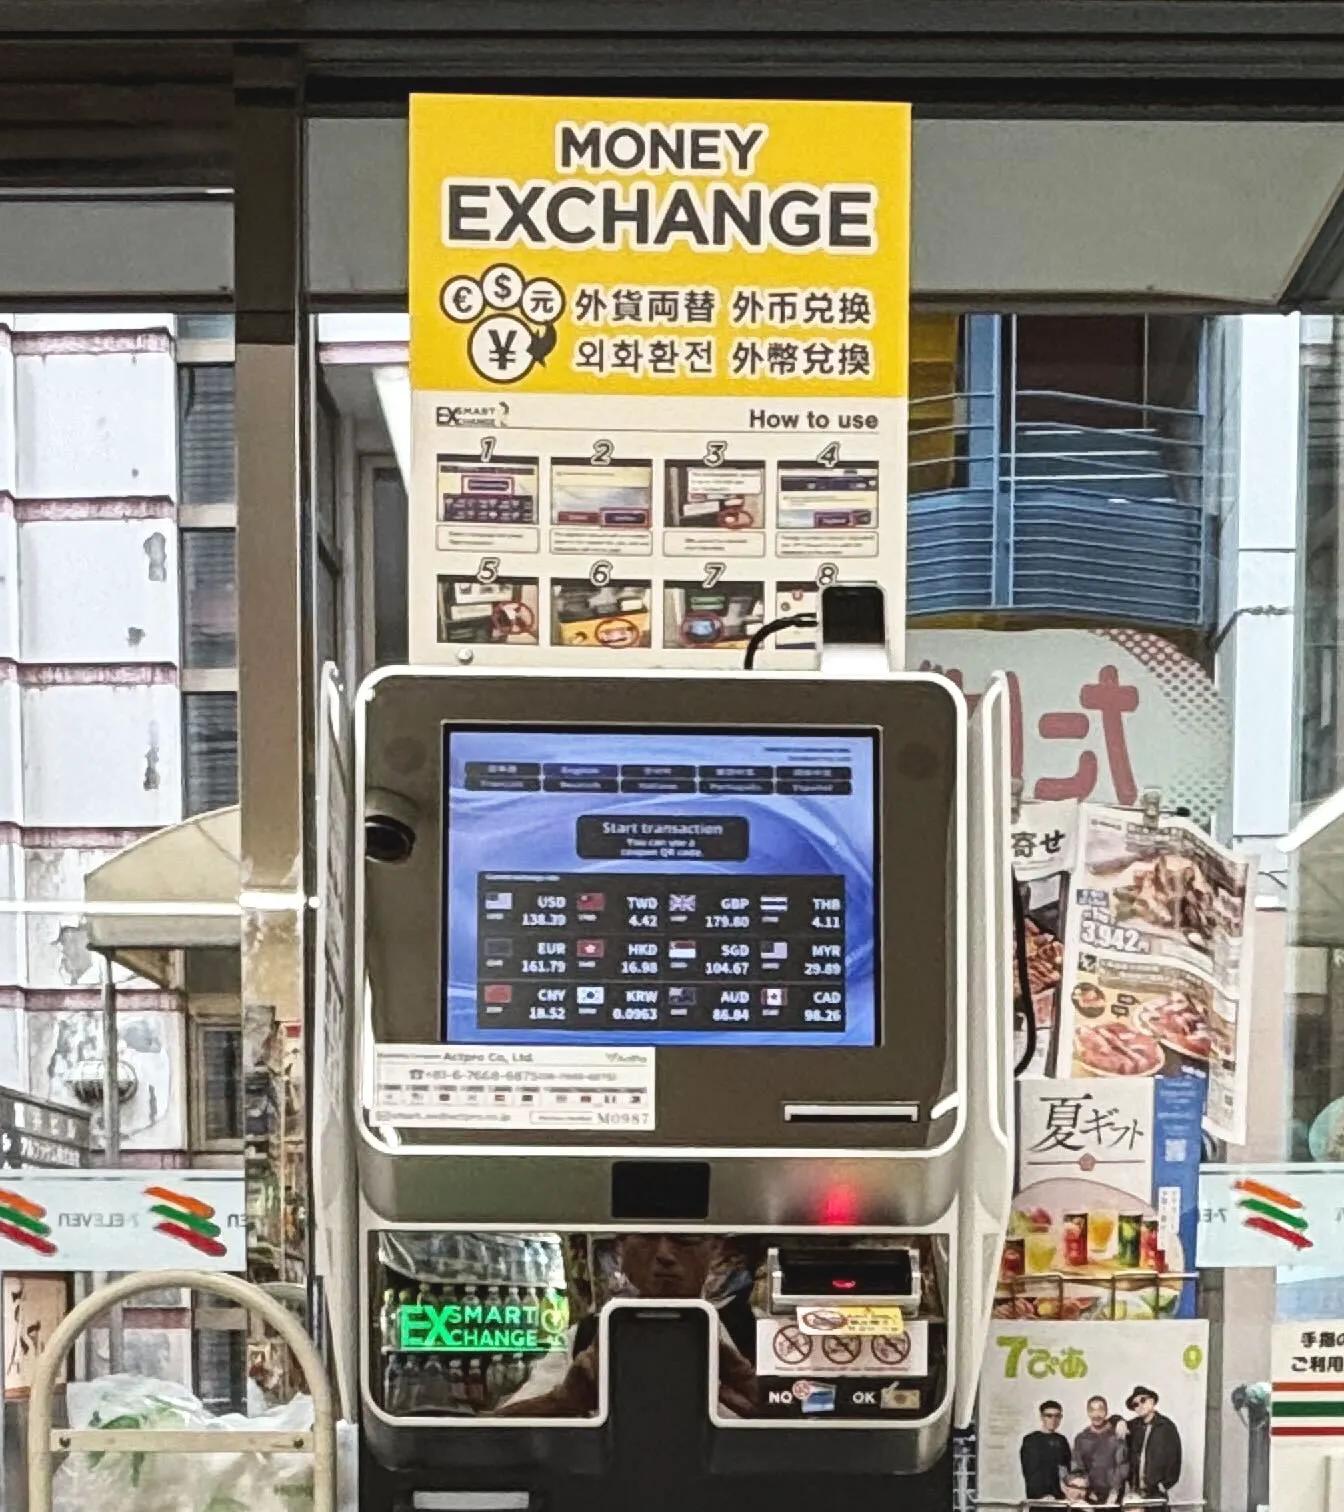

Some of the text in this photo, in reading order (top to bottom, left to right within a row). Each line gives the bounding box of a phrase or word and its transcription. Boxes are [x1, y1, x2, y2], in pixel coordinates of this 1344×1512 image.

[561, 126, 763, 170] MONEY
[447, 184, 873, 249] EXCHANGE
[575, 288, 716, 324] 外貨両替
[575, 340, 714, 375] 외화환전
[749, 410, 879, 430] How to use
[480, 438, 496, 462] 1
[591, 440, 614, 465] 2
[704, 441, 727, 466] 3
[816, 442, 841, 468] 4
[477, 558, 502, 583] 5
[590, 560, 613, 585] 6
[703, 562, 727, 588] 7
[816, 562, 838, 587] 8
[602, 822, 724, 835] Start transaction
[536, 895, 842, 910] USD TWD GBP THB
[628, 914, 659, 927] 4.42
[811, 916, 841, 928] 4.11
[536, 942, 842, 957] EUR HKD SGD MYR
[521, 960, 567, 973] 161.79
[705, 962, 750, 975] 104.67
[536, 988, 842, 1003] CNY KRW AUD CAD
[1029, 1092, 1145, 1153] 夏ギフト
[400, 1304, 540, 1346] EX SMART
[768, 1391, 876, 1404] NO OK
